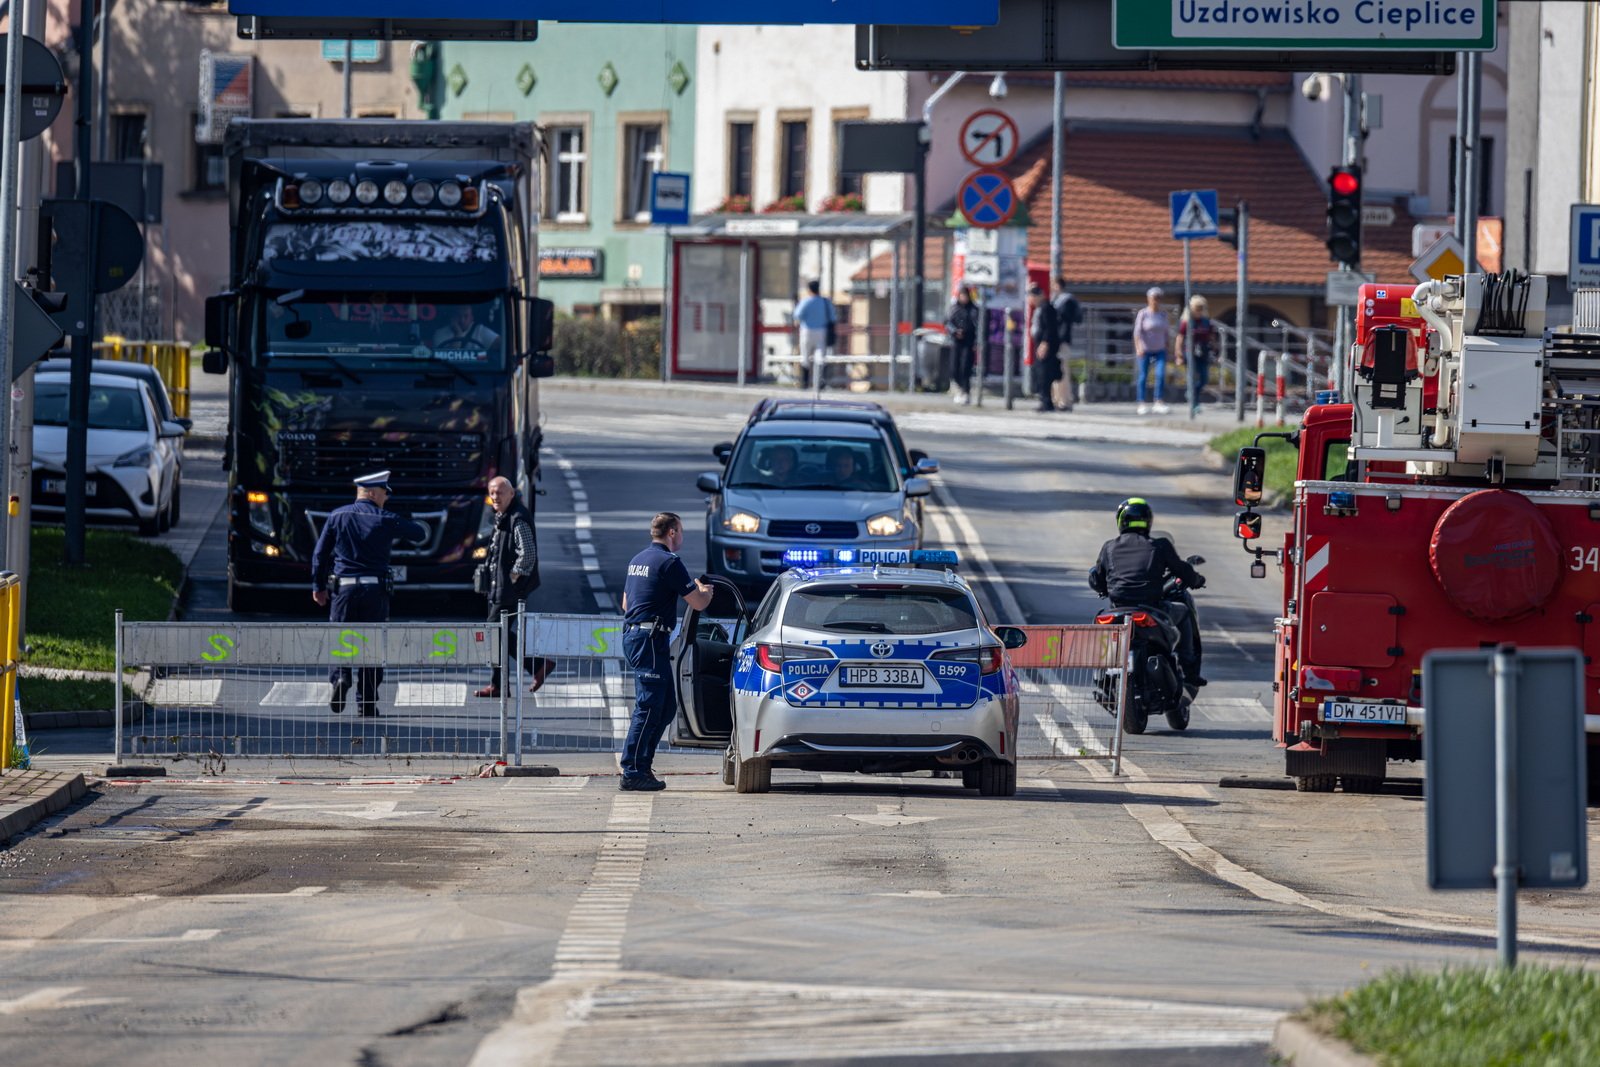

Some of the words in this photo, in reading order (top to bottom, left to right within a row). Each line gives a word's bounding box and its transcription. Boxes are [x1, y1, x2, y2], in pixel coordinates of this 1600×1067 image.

[1179, 0, 1341, 24] Uzdrowisko
[1354, 0, 1476, 32] Cieplice
[277, 433, 317, 441] VOLVO
[862, 551, 908, 563] POLICJA
[1569, 545, 1600, 573] 34
[788, 664, 830, 676] POLICJA
[850, 668, 878, 683] HPB
[883, 668, 919, 683] 33BA
[939, 665, 967, 676] B599
[1333, 704, 1355, 719] DW
[1359, 705, 1404, 721] 451VH
